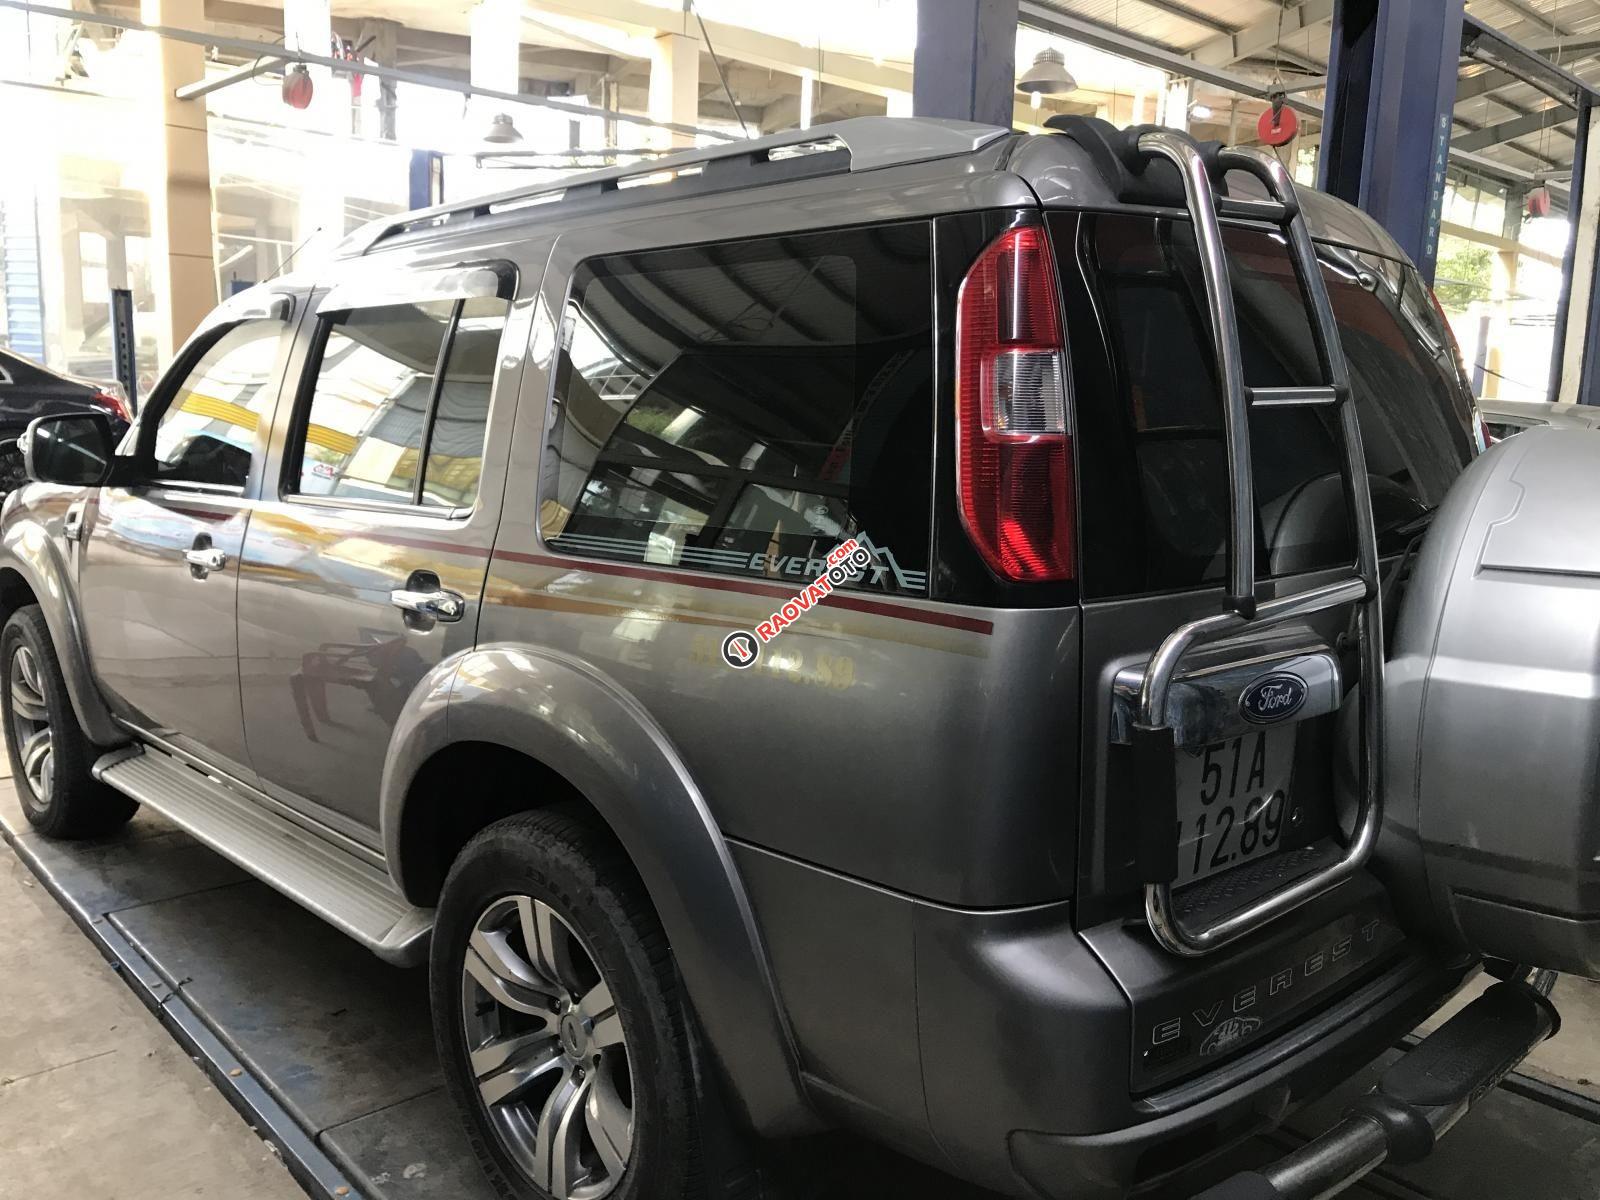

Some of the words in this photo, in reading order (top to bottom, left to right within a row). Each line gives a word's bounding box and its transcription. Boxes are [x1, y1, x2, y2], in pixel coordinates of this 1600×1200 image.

[1426, 117, 1448, 255] STANDARD
[750, 552, 889, 584] EVERST
[1257, 683, 1293, 711] Ford
[1200, 731, 1266, 806] 51A
[1152, 919, 1380, 1045] EVEREST
